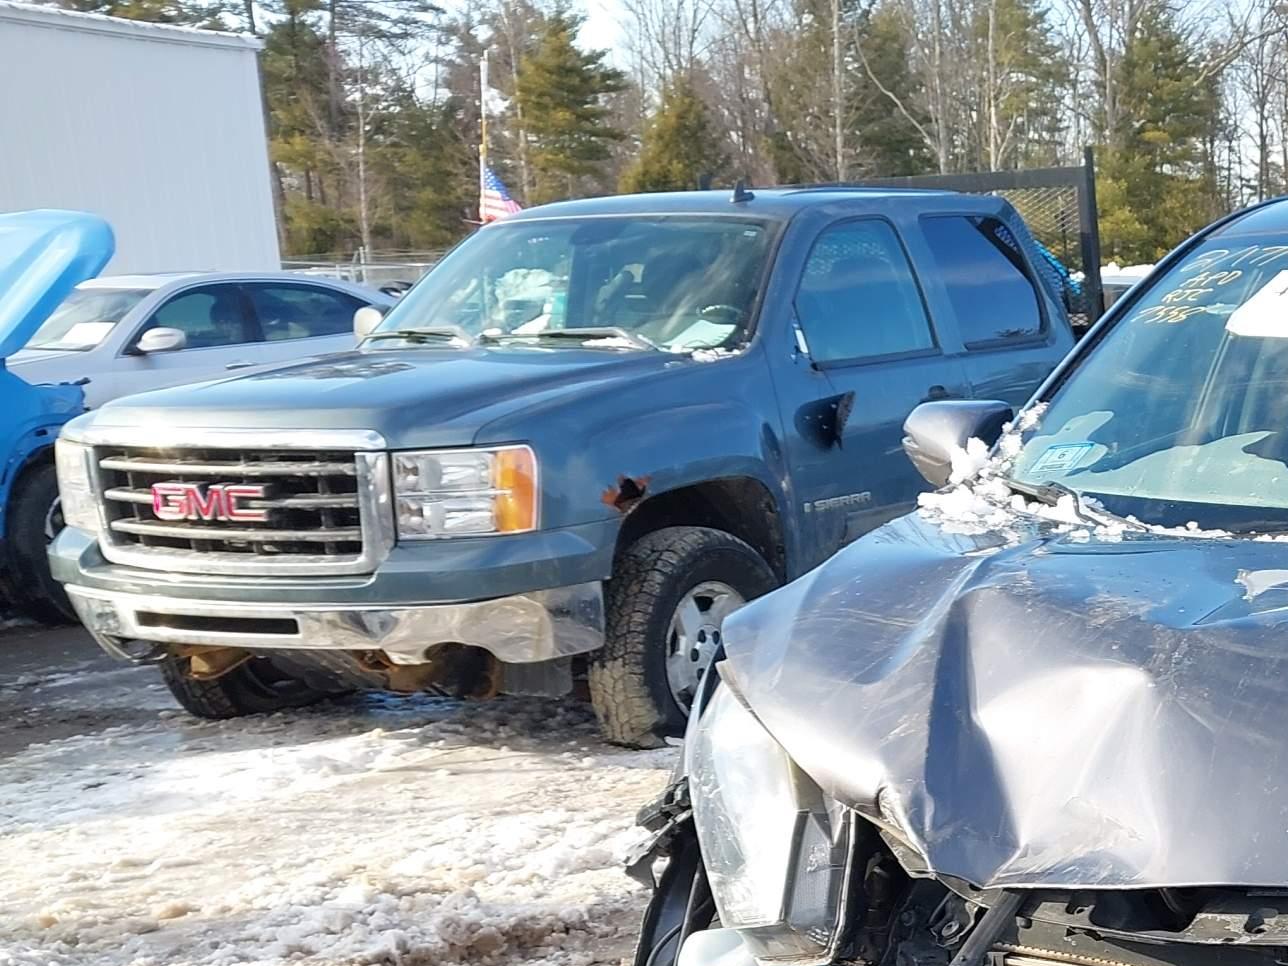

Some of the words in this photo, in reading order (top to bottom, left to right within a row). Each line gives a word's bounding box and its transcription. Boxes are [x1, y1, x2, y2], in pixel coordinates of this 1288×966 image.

[1179, 270, 1243, 288] APD
[151, 482, 269, 521] GMC
[813, 491, 871, 511] SIERRA
